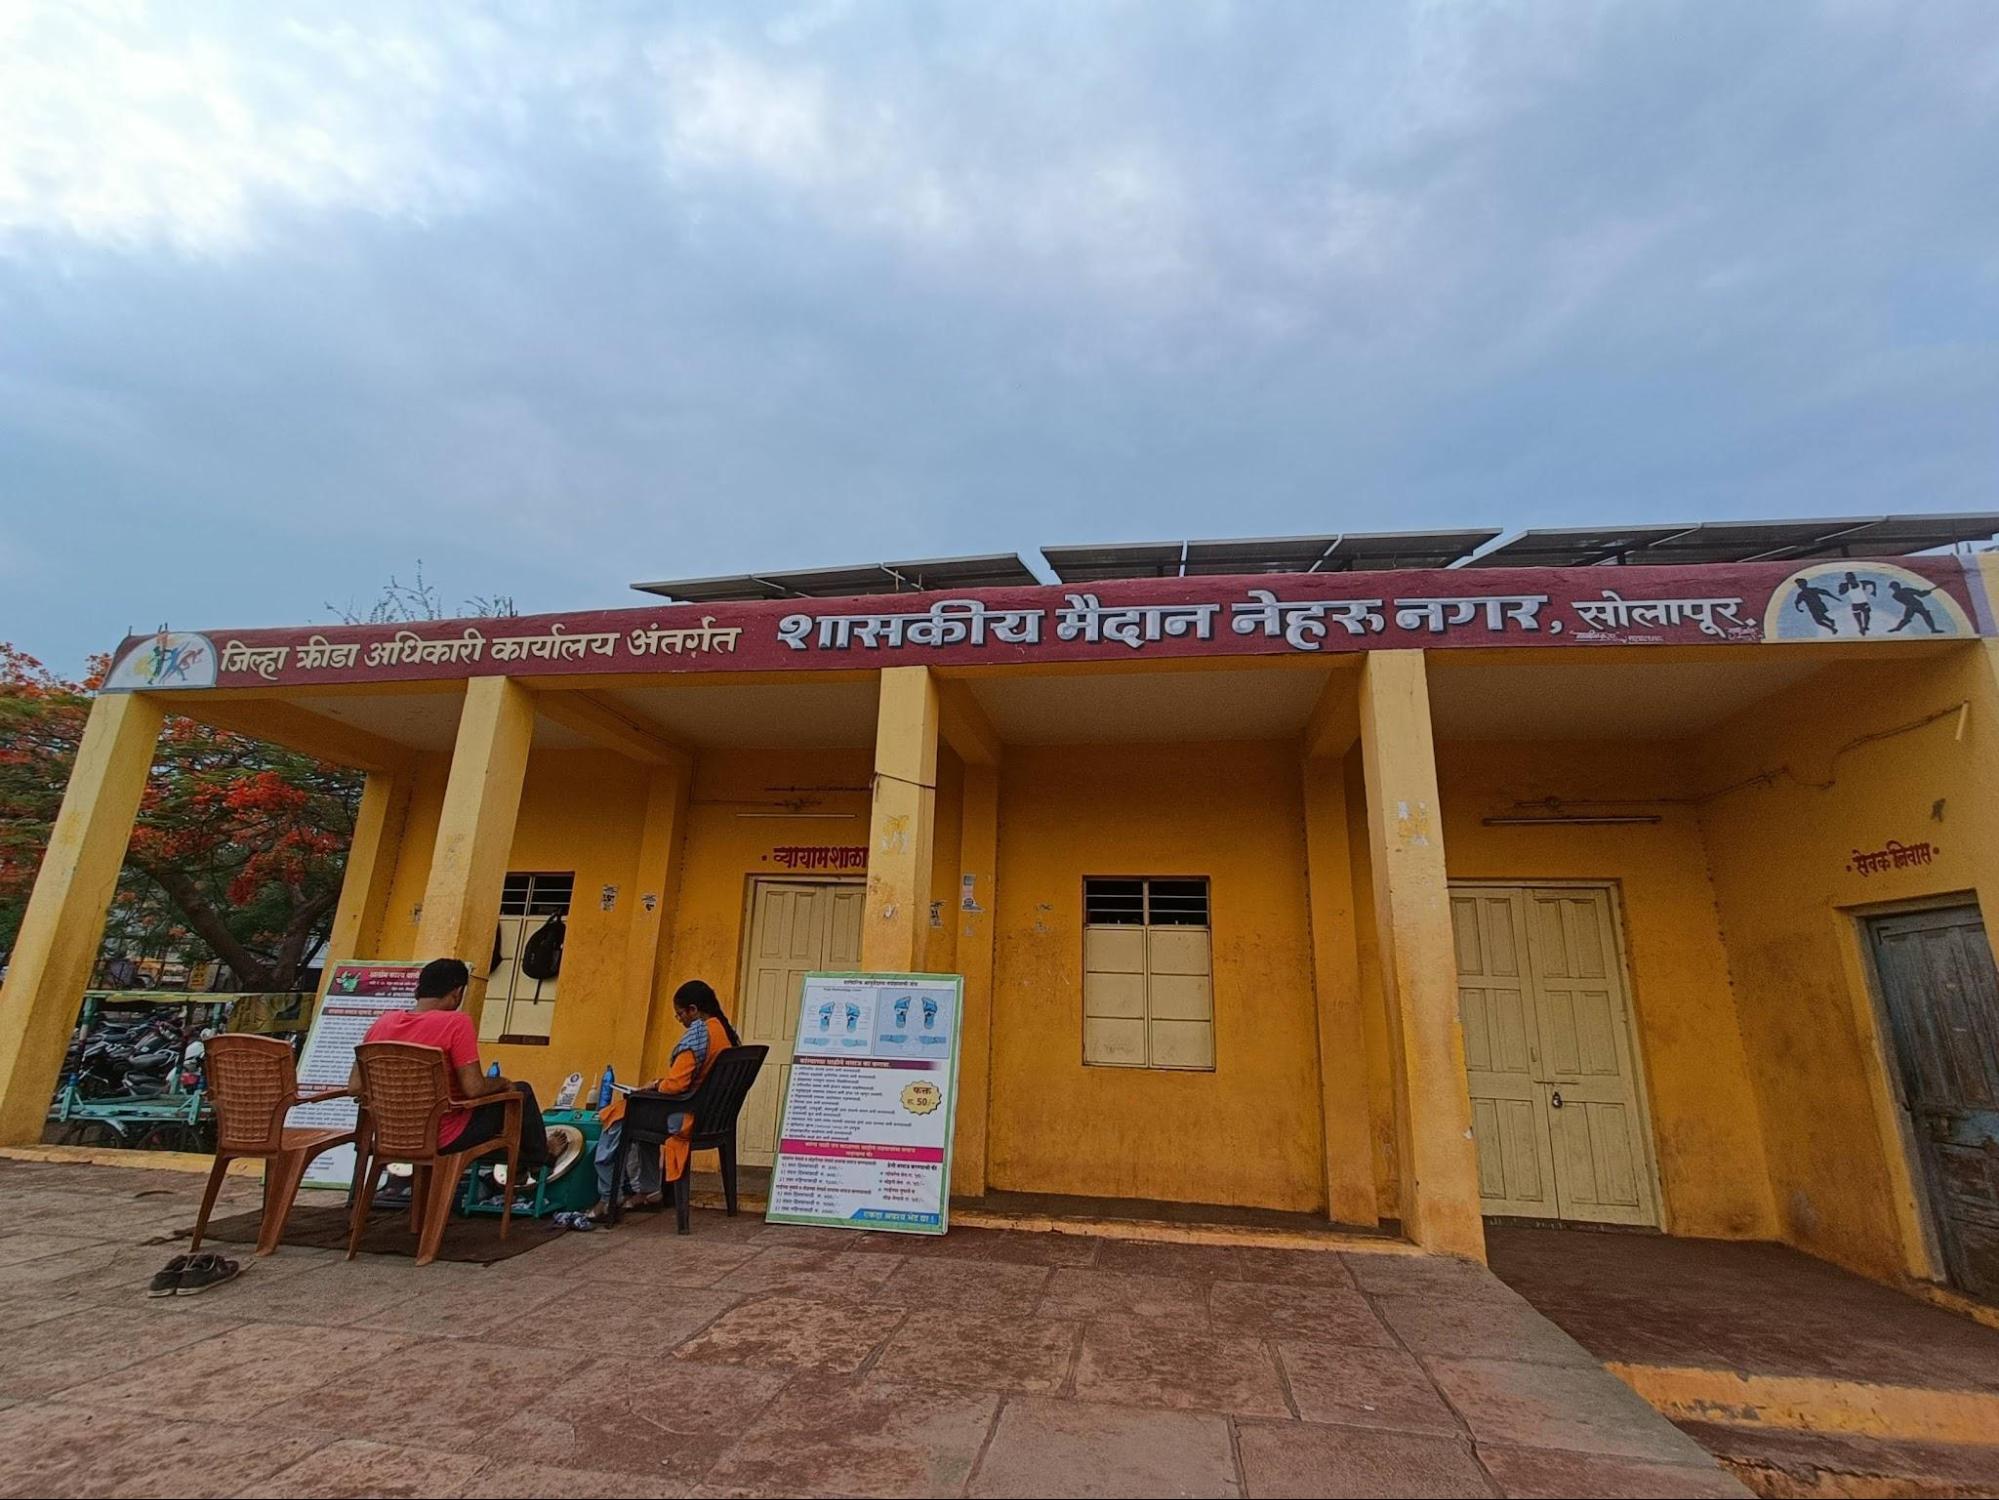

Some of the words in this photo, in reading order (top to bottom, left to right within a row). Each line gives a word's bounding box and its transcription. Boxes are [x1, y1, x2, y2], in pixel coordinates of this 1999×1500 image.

[220, 639, 289, 681] जिल्हा
[295, 634, 360, 671] क्रीडा
[364, 626, 486, 668] अधिकारी
[491, 623, 620, 662] कार्यालय
[626, 616, 742, 656] अंतर्गत
[777, 599, 1045, 650] शासकीय
[1055, 593, 1220, 649] मैदान
[1395, 595, 1562, 635] नगर,
